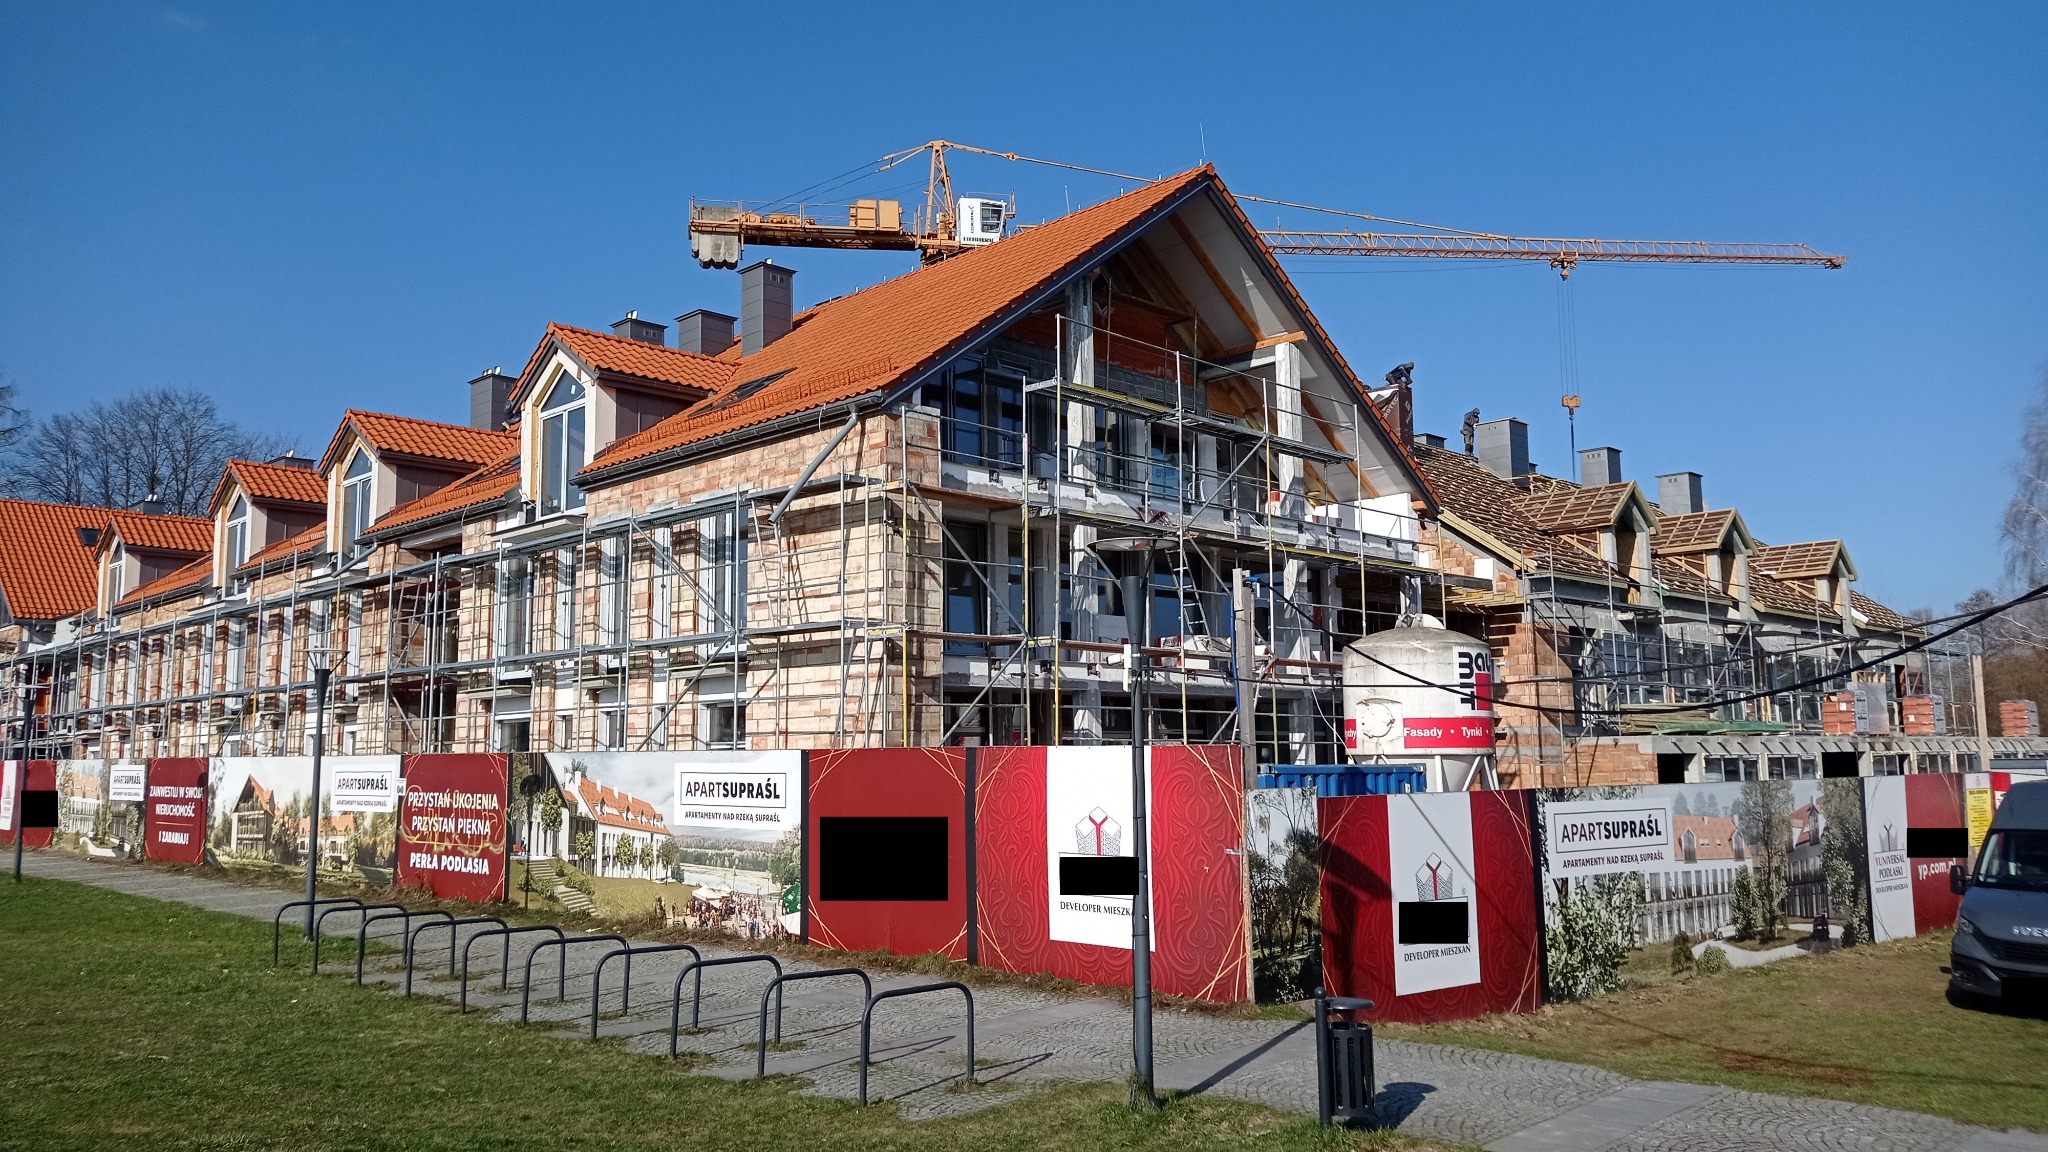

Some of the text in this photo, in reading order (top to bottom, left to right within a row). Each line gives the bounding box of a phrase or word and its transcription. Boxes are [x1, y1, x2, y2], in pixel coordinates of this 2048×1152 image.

[1403, 727, 1443, 739] Fasady
[1461, 726, 1483, 738] Tynki
[337, 775, 388, 790] APARTSUPRAŚL
[685, 777, 780, 799] APARTSUPRAŚL
[149, 785, 179, 798] ZAINWESTUJ
[179, 786, 185, 798] W
[185, 786, 204, 801] SWOJĄ
[407, 788, 499, 810] PRZYSTAŃ UKOJENIA
[155, 802, 195, 817] NIERUCHOMOŚĆ
[684, 811, 780, 823] APARTAMENTY NAD RZEKĄ SUPRAŚL
[411, 813, 492, 839] PRZYSTAŃ PIĘKNA
[1561, 813, 1662, 843] APARTSUPRAŚL
[409, 852, 490, 875] PERŁA PODLASIA
[1562, 849, 1664, 869] APARTAMENTY NAD RZEKĄ SUPRAŚL
[1060, 901, 1133, 917] DEVELOPER MIESZK
[1404, 949, 1440, 962] DEVELOPER
